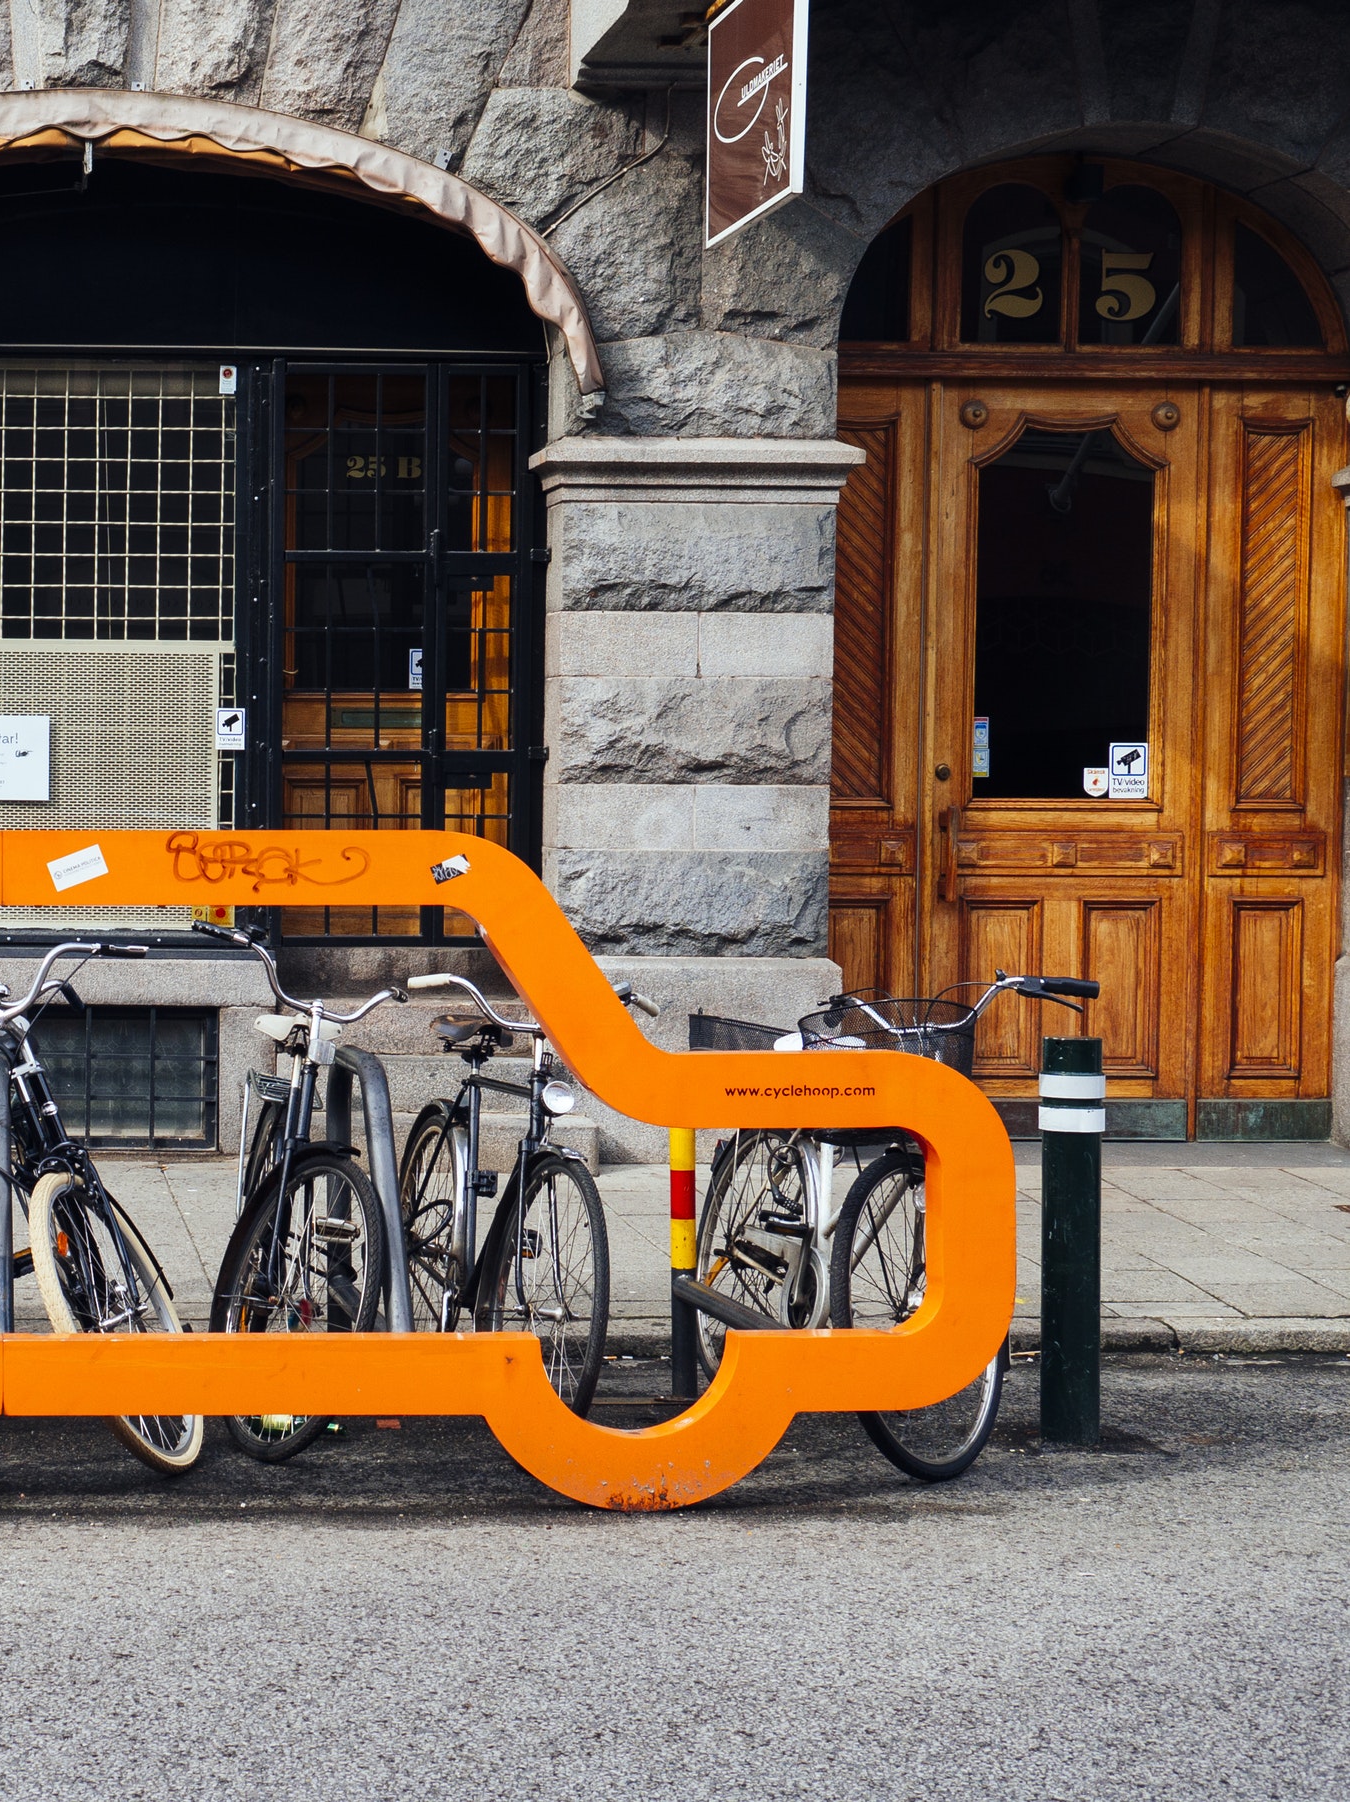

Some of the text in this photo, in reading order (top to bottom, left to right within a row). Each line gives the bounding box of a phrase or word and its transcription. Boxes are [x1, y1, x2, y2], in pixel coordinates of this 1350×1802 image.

[346, 456, 422, 478] 25 B
[1112, 787, 1145, 795] bevakning
[724, 1084, 876, 1100] www.cyclehoop.com
